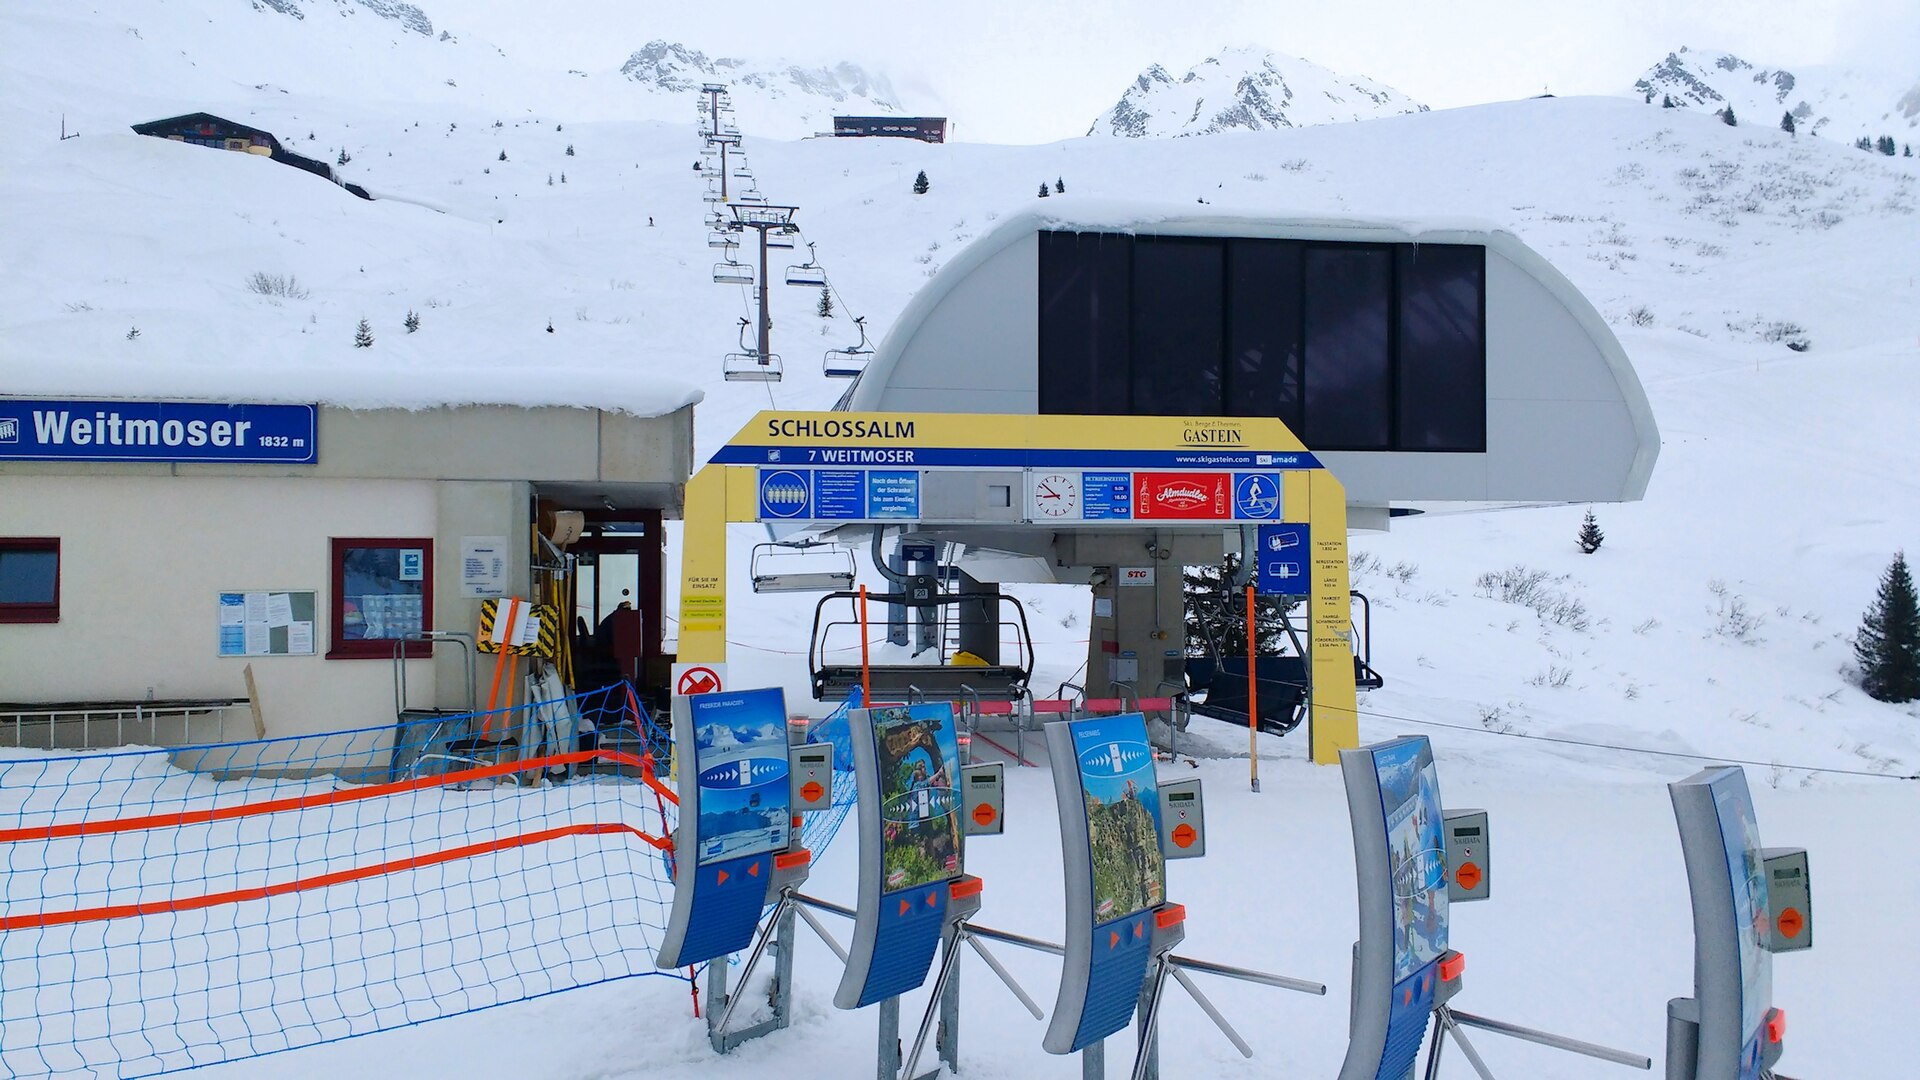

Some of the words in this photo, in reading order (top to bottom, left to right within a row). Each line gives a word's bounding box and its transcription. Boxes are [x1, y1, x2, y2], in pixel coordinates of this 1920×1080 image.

[33, 410, 250, 447] Weitmoser
[258, 436, 288, 447] 1832
[292, 438, 304, 447] m
[768, 419, 914, 438] SCHLOSSALM
[1183, 429, 1241, 443] GASTEIN
[808, 450, 817, 462] 7
[822, 450, 914, 463] WEITMOSER
[1176, 456, 1250, 464] www.skigastein.com
[1156, 487, 1208, 502] Almdudler
[1126, 570, 1147, 578] STG
[916, 589, 926, 597] 20
[1454, 837, 1481, 845] SKIDATA
